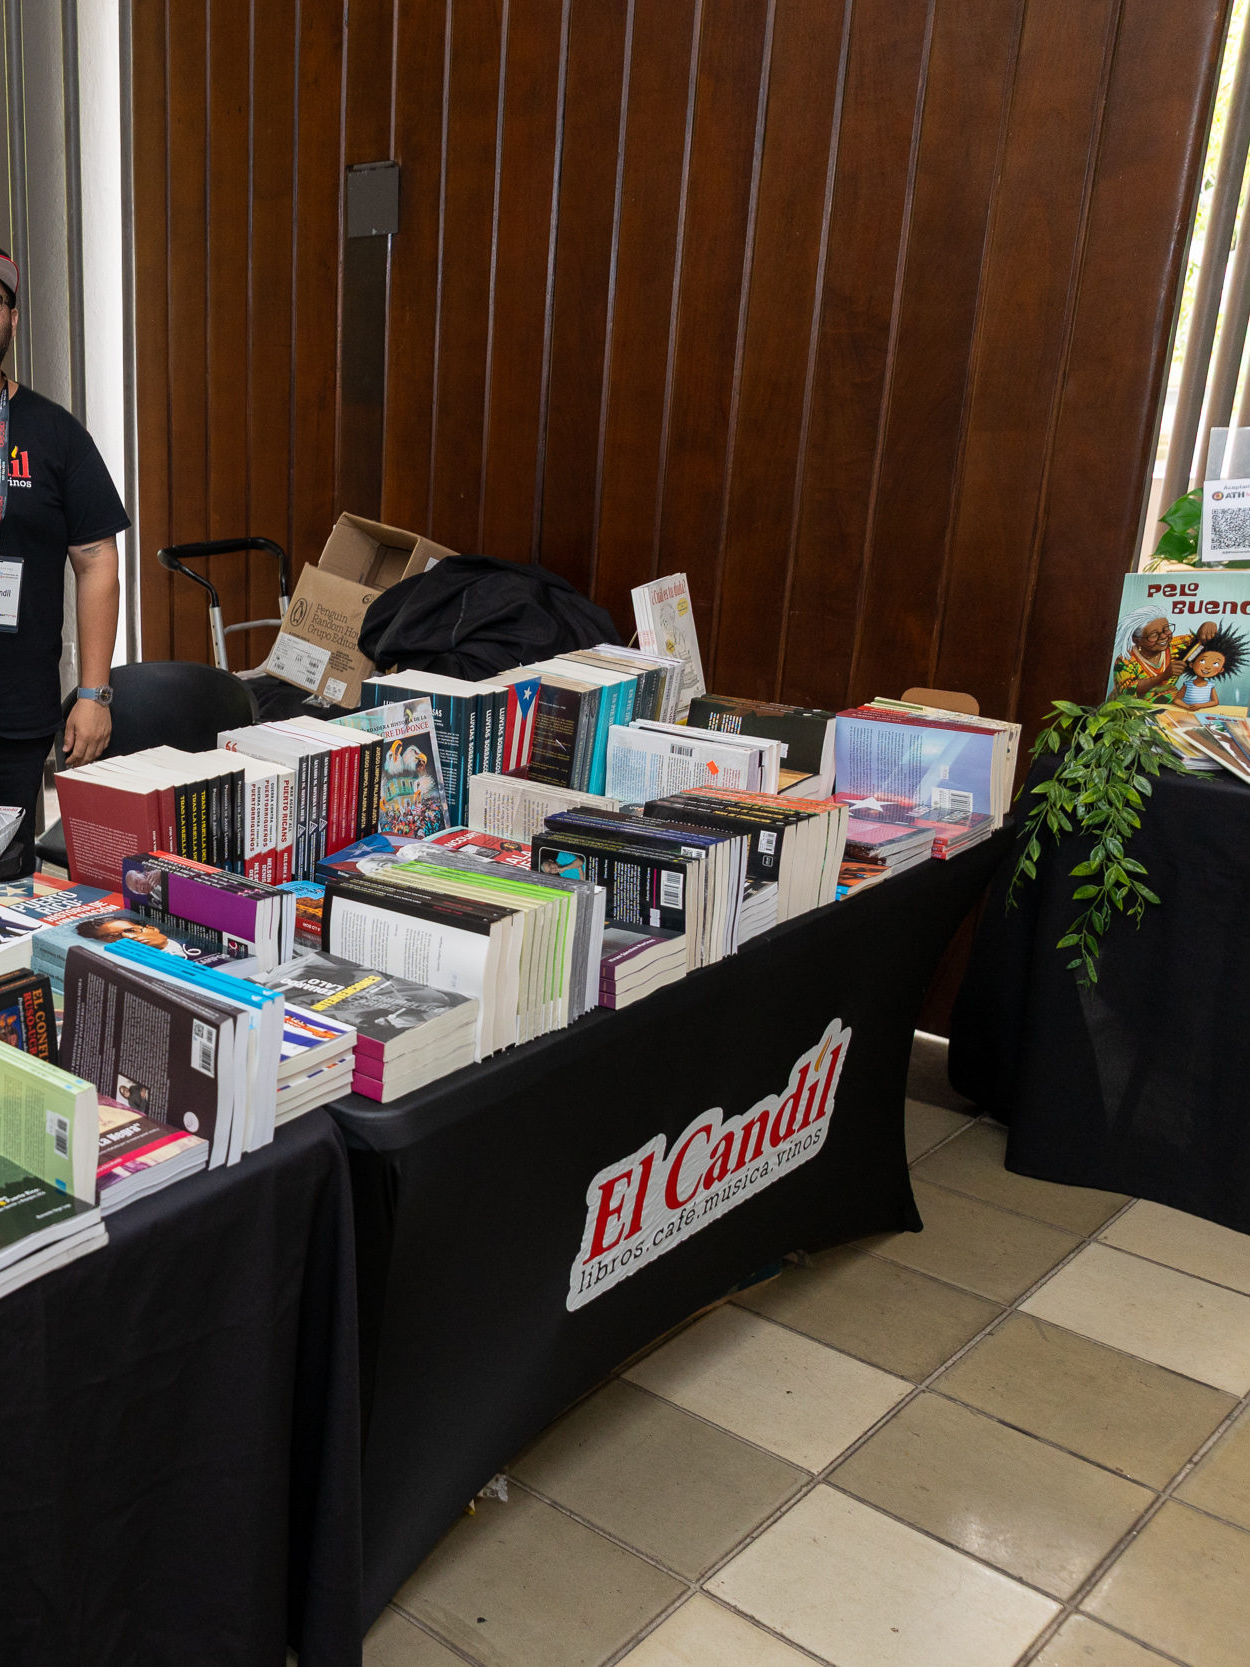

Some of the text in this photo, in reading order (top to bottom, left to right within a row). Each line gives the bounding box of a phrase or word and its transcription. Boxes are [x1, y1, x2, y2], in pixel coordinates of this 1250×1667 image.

[1225, 491, 1245, 499] ATH
[312, 615, 344, 635] Random
[315, 604, 348, 624] Penguin
[307, 625, 332, 643] Grupo
[331, 634, 359, 652] Editor
[611, 693, 617, 703] EN
[627, 688, 634, 698] EN
[467, 712, 476, 740] LLUVIAS
[483, 709, 492, 737] LLUVIAS
[496, 707, 506, 735] LLUVIAS
[624, 712, 630, 722] DE
[395, 721, 430, 736] DE PONCE
[362, 749, 371, 767] JUEGO
[372, 746, 381, 764] JUEGO
[198, 790, 206, 808] TRAS
[358, 787, 370, 811] PALABRA
[369, 783, 380, 808] PALABRA
[200, 809, 206, 819] LA
[245, 783, 259, 851] PUERTORRIQUEÑOS
[259, 779, 272, 847] PUERTORRIQUEÑOS
[277, 779, 292, 843] PUERTO RICANS
[286, 798, 295, 821] AGAINST
[359, 811, 367, 828] JUSTA
[369, 808, 378, 824] JUSTA
[178, 795, 188, 853] TRAS LA HUELLA
[190, 792, 199, 850] TRAS LA HUELLA
[198, 820, 208, 847] HUELLA
[265, 857, 273, 882] NELSON
[281, 852, 289, 873] NELSON
[10, 890, 78, 914] PUERTO
[37, 899, 84, 916] RICO:
[44, 900, 108, 924] HISTORIA DE
[279, 978, 337, 996] EDUARDO
[307, 978, 345, 992] LALO
[32, 988, 46, 1009] EL
[23, 992, 37, 1055] RUSO-UCR
[582, 1034, 844, 1266] El Candil
